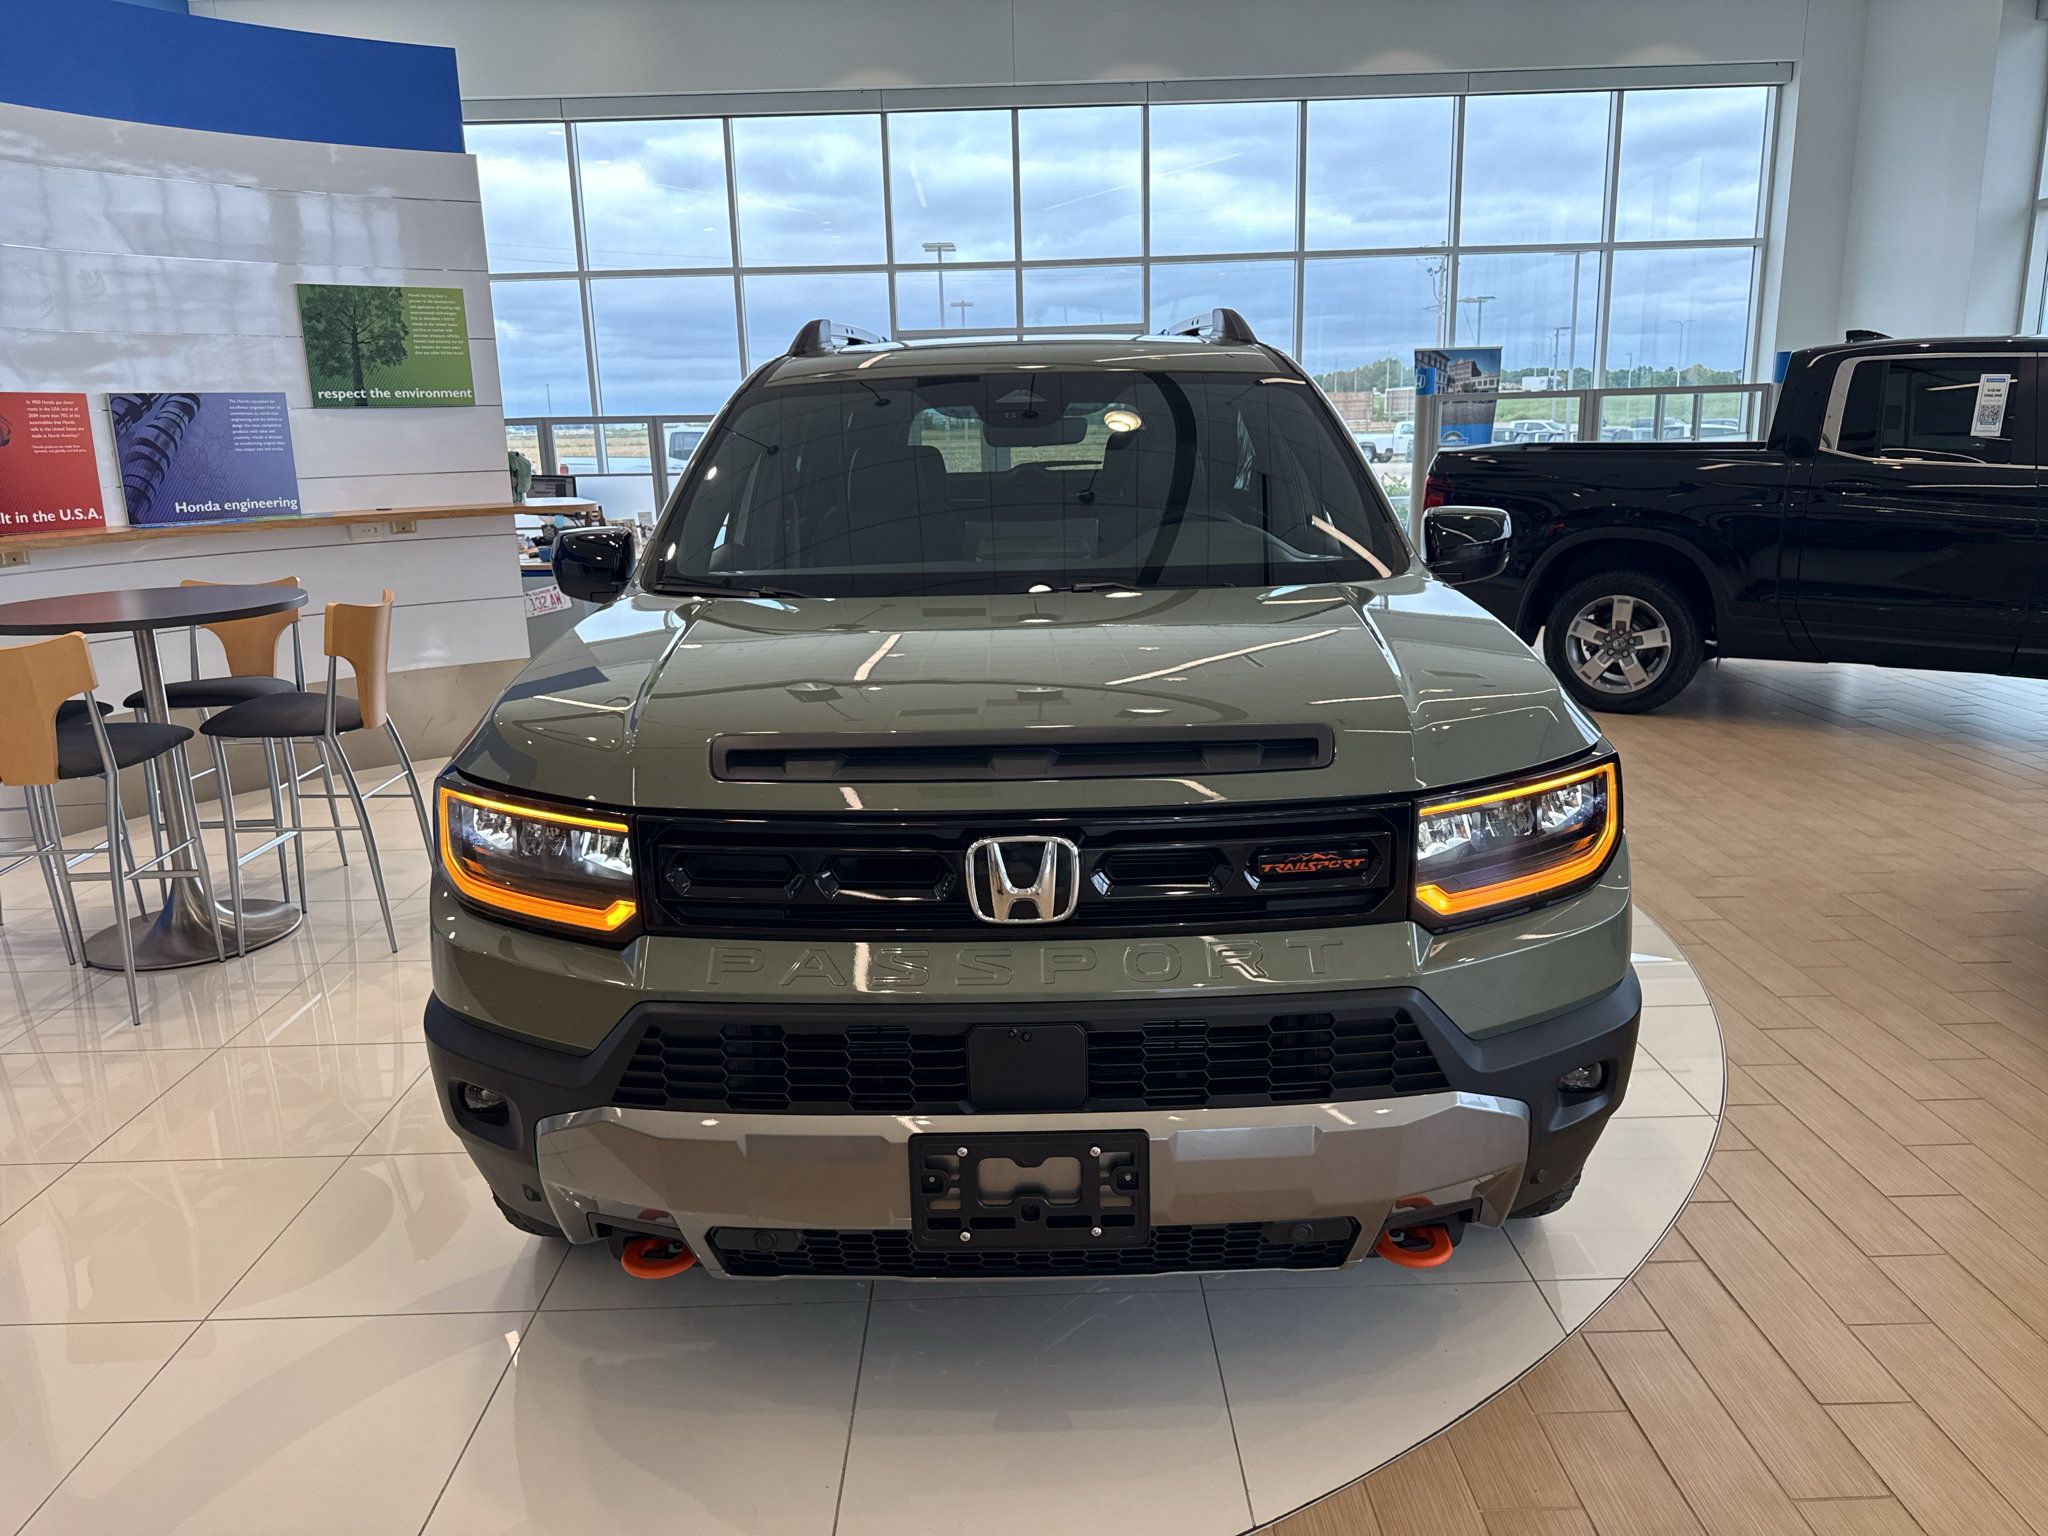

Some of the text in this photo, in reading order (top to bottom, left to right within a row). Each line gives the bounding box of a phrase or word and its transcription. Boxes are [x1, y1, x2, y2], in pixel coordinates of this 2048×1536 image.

[318, 387, 472, 401] respect the environment
[175, 497, 298, 513] Honda engineering
[15, 511, 29, 524] in
[32, 510, 56, 523] the
[59, 508, 103, 521] U.S.A.
[1260, 858, 1366, 873] TRAILSPORT
[707, 937, 1343, 987] PASSPORT
